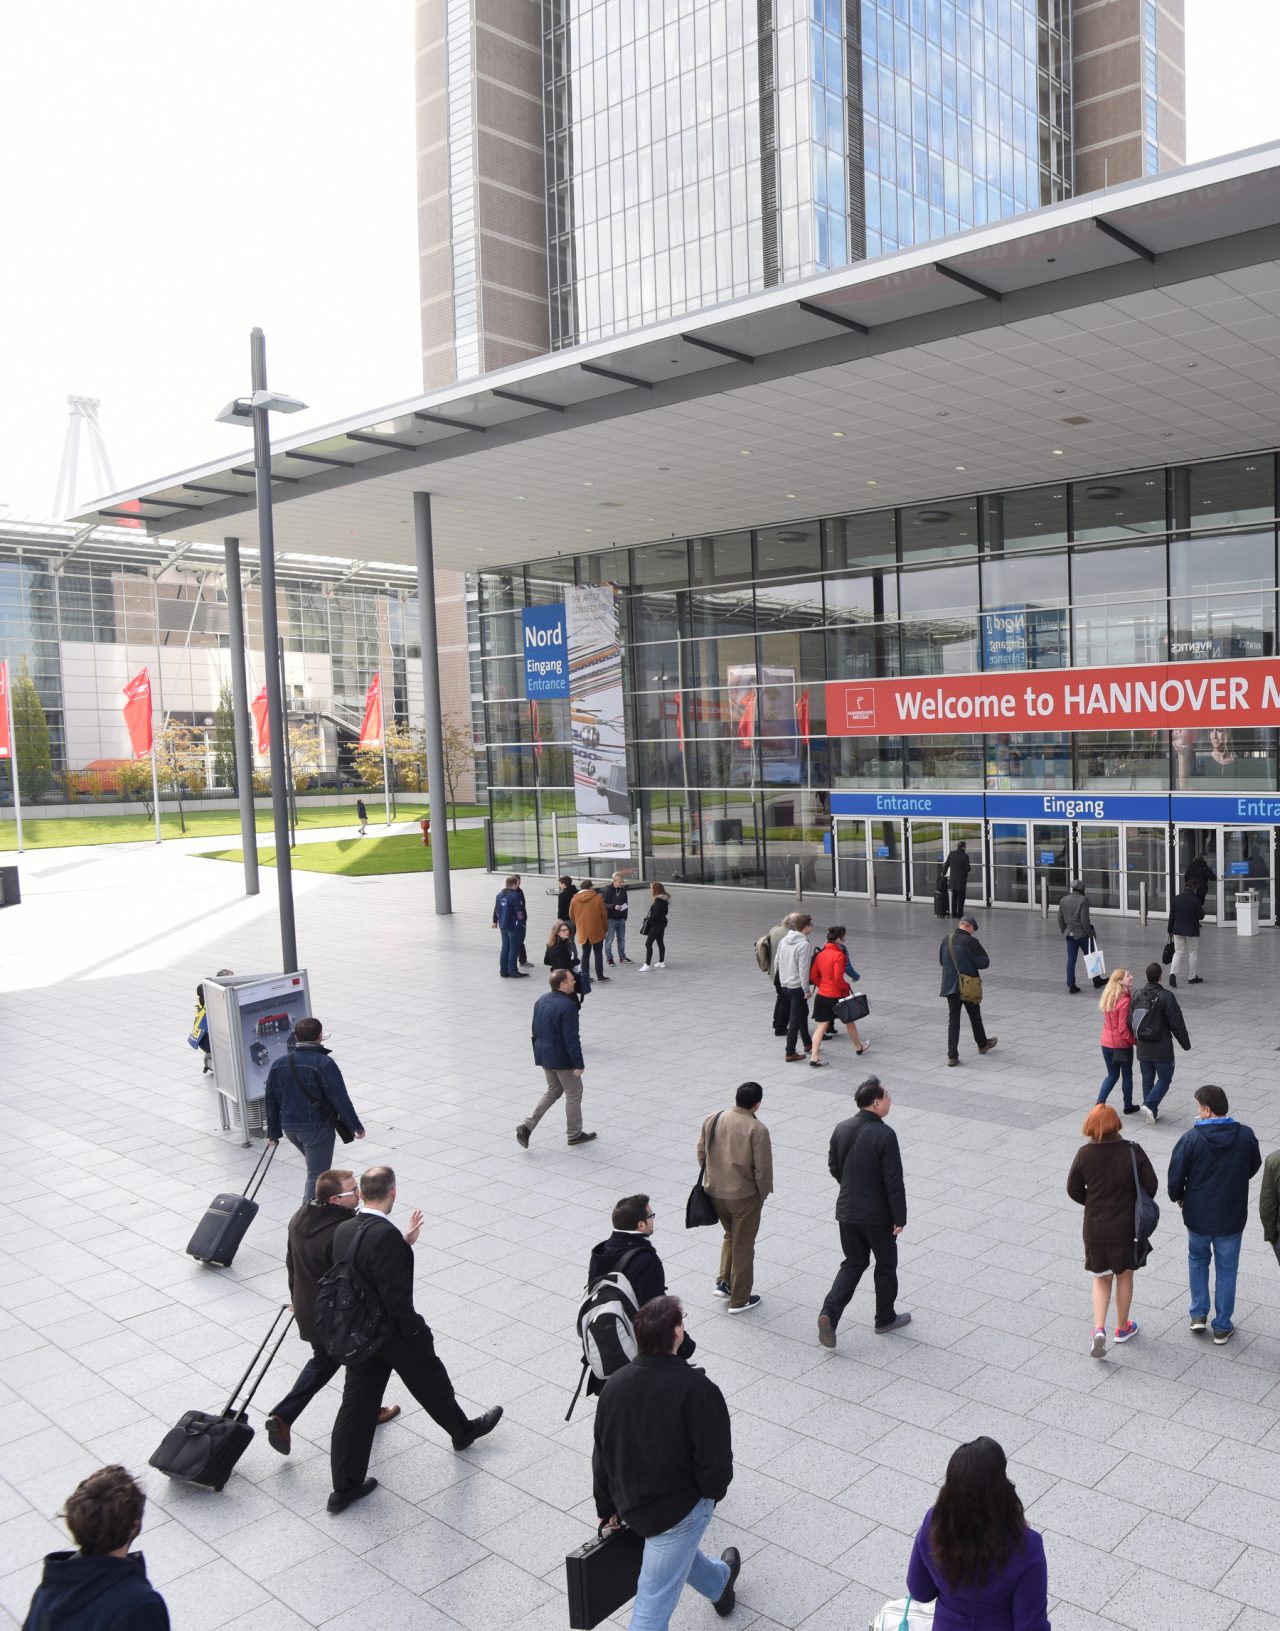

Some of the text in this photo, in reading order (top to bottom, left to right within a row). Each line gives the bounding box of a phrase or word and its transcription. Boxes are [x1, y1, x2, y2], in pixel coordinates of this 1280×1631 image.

[525, 622, 562, 648] Nord
[527, 659, 562, 676] Eingang
[528, 678, 566, 691] Entrance
[895, 689, 1016, 720] Welcome
[1024, 687, 1054, 717] to
[1064, 677, 1250, 715] HANNOVER
[876, 795, 932, 811] Entrance
[1043, 796, 1104, 818] Eingang
